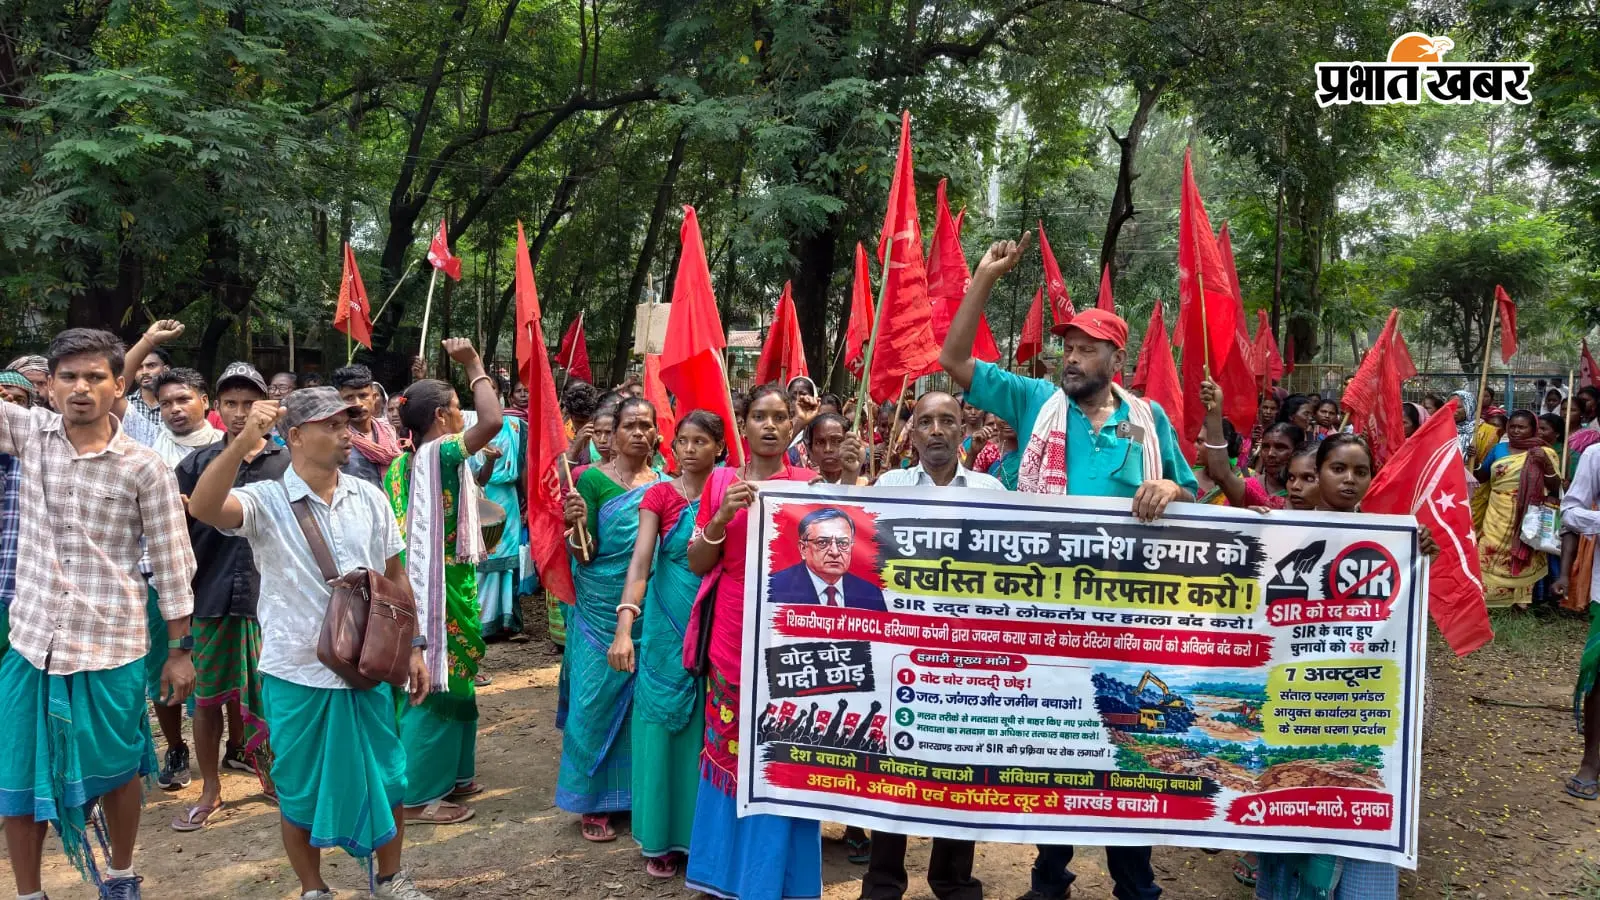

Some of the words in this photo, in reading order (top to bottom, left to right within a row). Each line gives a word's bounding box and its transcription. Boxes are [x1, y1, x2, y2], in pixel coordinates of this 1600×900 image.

[893, 525, 963, 556] चुनाव
[968, 527, 1051, 562] आयुक्त
[1058, 527, 1136, 562] ज्ञानेश
[1142, 537, 1211, 570] कुमार
[1216, 538, 1249, 566] को
[892, 560, 987, 595] बर्खास्त
[1073, 569, 1182, 606] गिरफ्तार
[893, 598, 926, 612] SIR
[975, 603, 1011, 616] करो
[1016, 604, 1087, 621] लोकतंत्र
[1091, 611, 1117, 623] पर
[1120, 613, 1174, 626] हमला
[1177, 613, 1206, 627] बंद
[1271, 603, 1302, 623] SIR
[1306, 602, 1325, 619] को
[786, 609, 835, 634] शिकारीपाड़ा
[837, 613, 848, 632] में
[848, 617, 882, 635] HPGCL
[884, 618, 921, 639] हरियाणा
[922, 622, 950, 641] कंपनी
[951, 628, 970, 643] द्वारा
[971, 629, 1001, 643] जबरन
[1002, 630, 1027, 645] कराए
[1028, 632, 1042, 646] जा
[1043, 629, 1057, 648] रहे
[1058, 630, 1082, 648] कोल
[1082, 630, 1112, 649] टेस्टिंग
[1113, 632, 1141, 651] बोरिंग
[1143, 634, 1164, 652] कार्य
[1165, 636, 1179, 653] को
[1181, 636, 1215, 655] अविलंब
[1217, 638, 1232, 656] बंद
[1233, 640, 1252, 657] करो
[1291, 625, 1317, 639] SIR
[1319, 624, 1330, 637] के
[1333, 625, 1354, 638] बाद
[1356, 625, 1374, 641] हुए
[779, 647, 814, 666] वोट
[817, 644, 852, 663] चोर
[1290, 639, 1327, 657] चुनावों
[1329, 639, 1347, 653] को
[916, 653, 950, 664] हमारी
[953, 655, 982, 668] मुख्य
[775, 666, 819, 689] गद्दी
[825, 661, 866, 687] छोड़
[902, 672, 910, 683] 1
[920, 672, 940, 684] वोट
[943, 673, 964, 685] चोर
[1285, 667, 1298, 682] 7
[1303, 664, 1383, 688] अक्टूबर
[900, 689, 911, 701] 2
[945, 690, 980, 706] जंगल
[980, 692, 1003, 707] और
[1002, 693, 1038, 709] जमीन
[1279, 688, 1313, 702] संताल
[1314, 691, 1350, 702] परगना
[1351, 689, 1386, 703] प्रमंडल
[899, 710, 911, 723] 3
[1273, 707, 1312, 722] आयुक्त
[1314, 705, 1357, 718] कार्यालय
[1359, 708, 1392, 723] दुमका
[946, 726, 958, 735] का
[987, 727, 999, 737] का
[1278, 721, 1291, 735] के
[1293, 724, 1322, 735] समक्ष
[1324, 725, 1349, 735] धरना
[1351, 723, 1387, 736] प्रदर्शन
[897, 734, 910, 748] 4
[954, 744, 974, 753] राज्य
[975, 742, 986, 754] में
[985, 743, 1005, 754] SIR
[1006, 743, 1018, 754] की
[1019, 744, 1045, 757] प्रक्रिया
[1046, 747, 1058, 756] पर
[1059, 746, 1075, 757] रोक
[789, 745, 812, 762] देश
[815, 752, 858, 769] बचाओ
[878, 758, 928, 778] लोकतंत्र
[930, 767, 974, 783] बचाओ
[998, 767, 1050, 785] संविधान
[1053, 770, 1097, 787] बचाओ
[1109, 772, 1168, 792] शिकारीपाड़ा
[1169, 776, 1203, 792] बचाओ
[806, 773, 862, 794] अडानी,
[866, 778, 918, 800] अंबानी
[921, 787, 948, 802] एवं
[1013, 791, 1040, 813] लूट
[1044, 791, 1060, 808] से
[1063, 792, 1114, 812] झारखंड
[1116, 796, 1160, 813] बचाओ
[1351, 800, 1390, 826] दुमका
